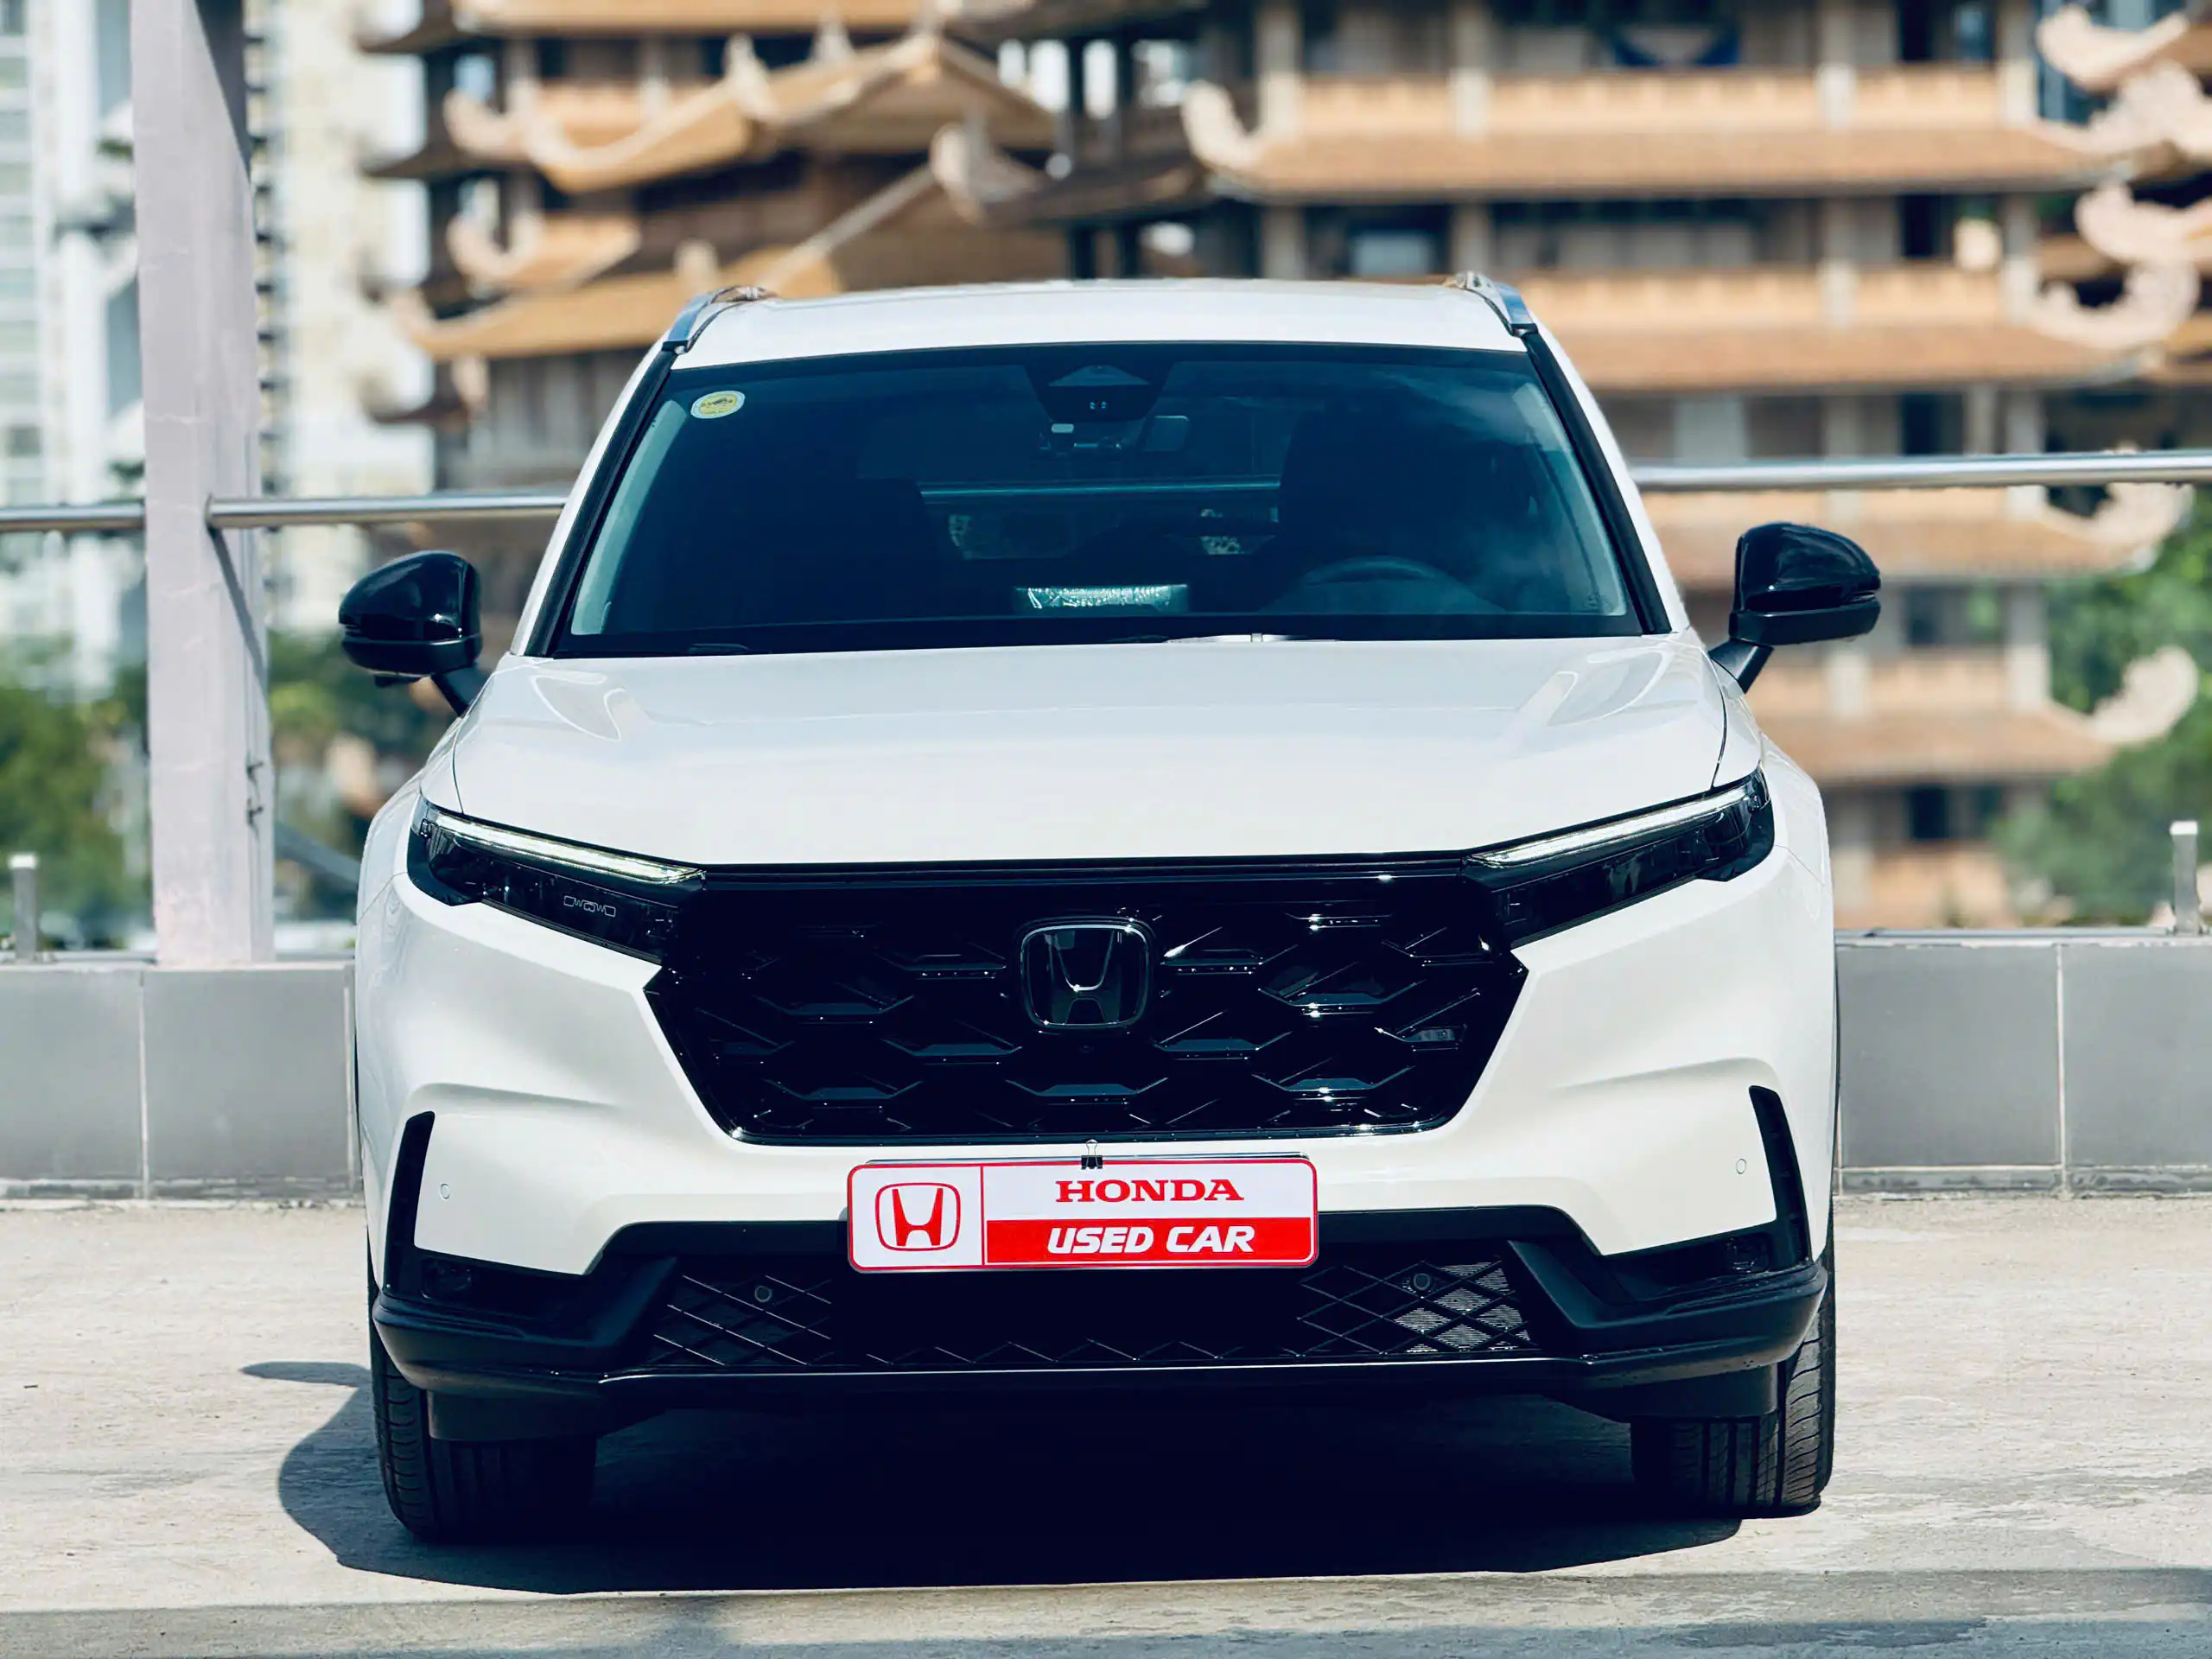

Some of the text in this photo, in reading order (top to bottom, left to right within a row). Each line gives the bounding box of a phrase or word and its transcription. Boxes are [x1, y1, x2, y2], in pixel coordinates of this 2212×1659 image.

[1056, 1179, 1245, 1203] HONDA
[1047, 1225, 1255, 1254] USED CAR
